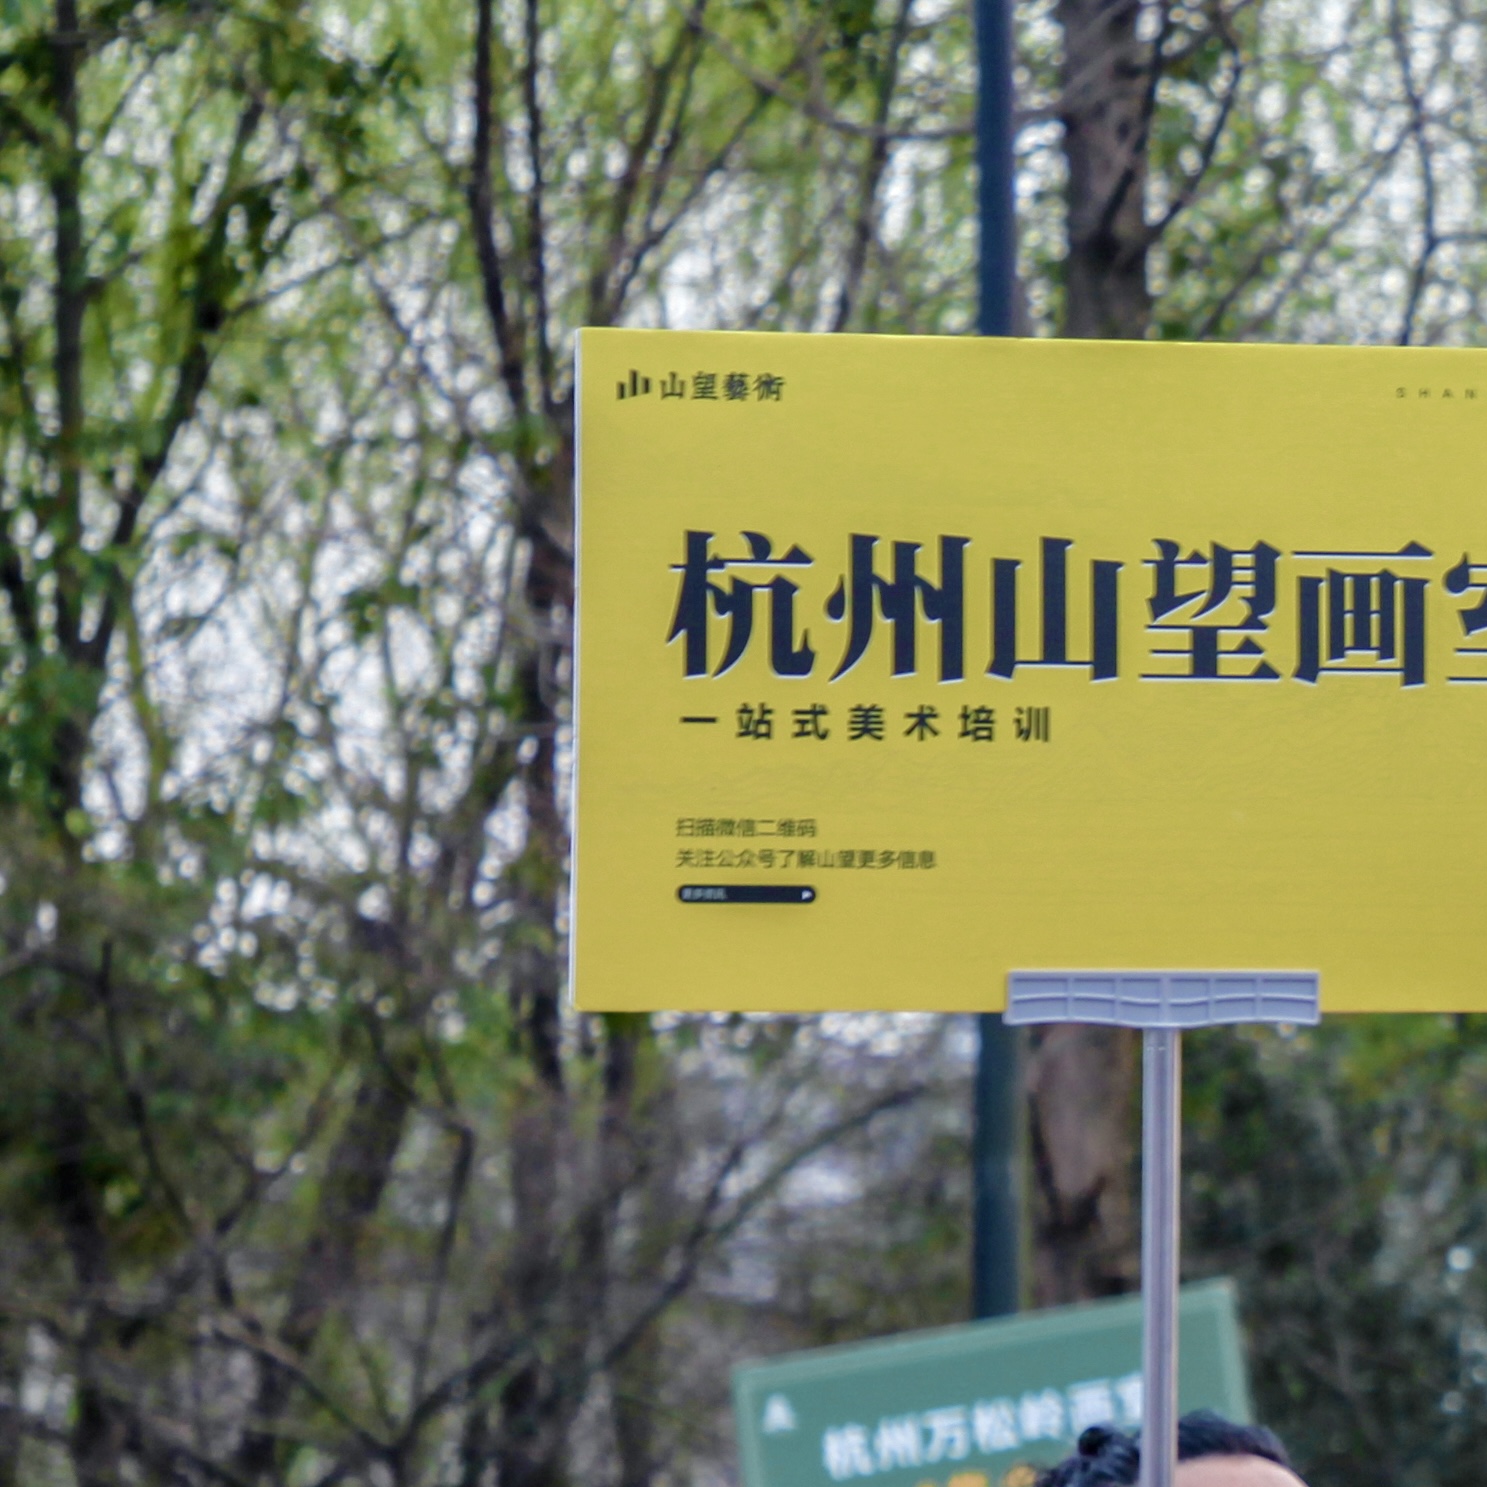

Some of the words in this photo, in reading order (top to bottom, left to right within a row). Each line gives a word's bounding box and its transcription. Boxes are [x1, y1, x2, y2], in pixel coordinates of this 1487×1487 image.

[680, 702, 1051, 742] 一站式美术培训
[675, 818, 817, 838] 扫描微信二维码
[675, 849, 936, 870] 关注公众号了解山望更多信息
